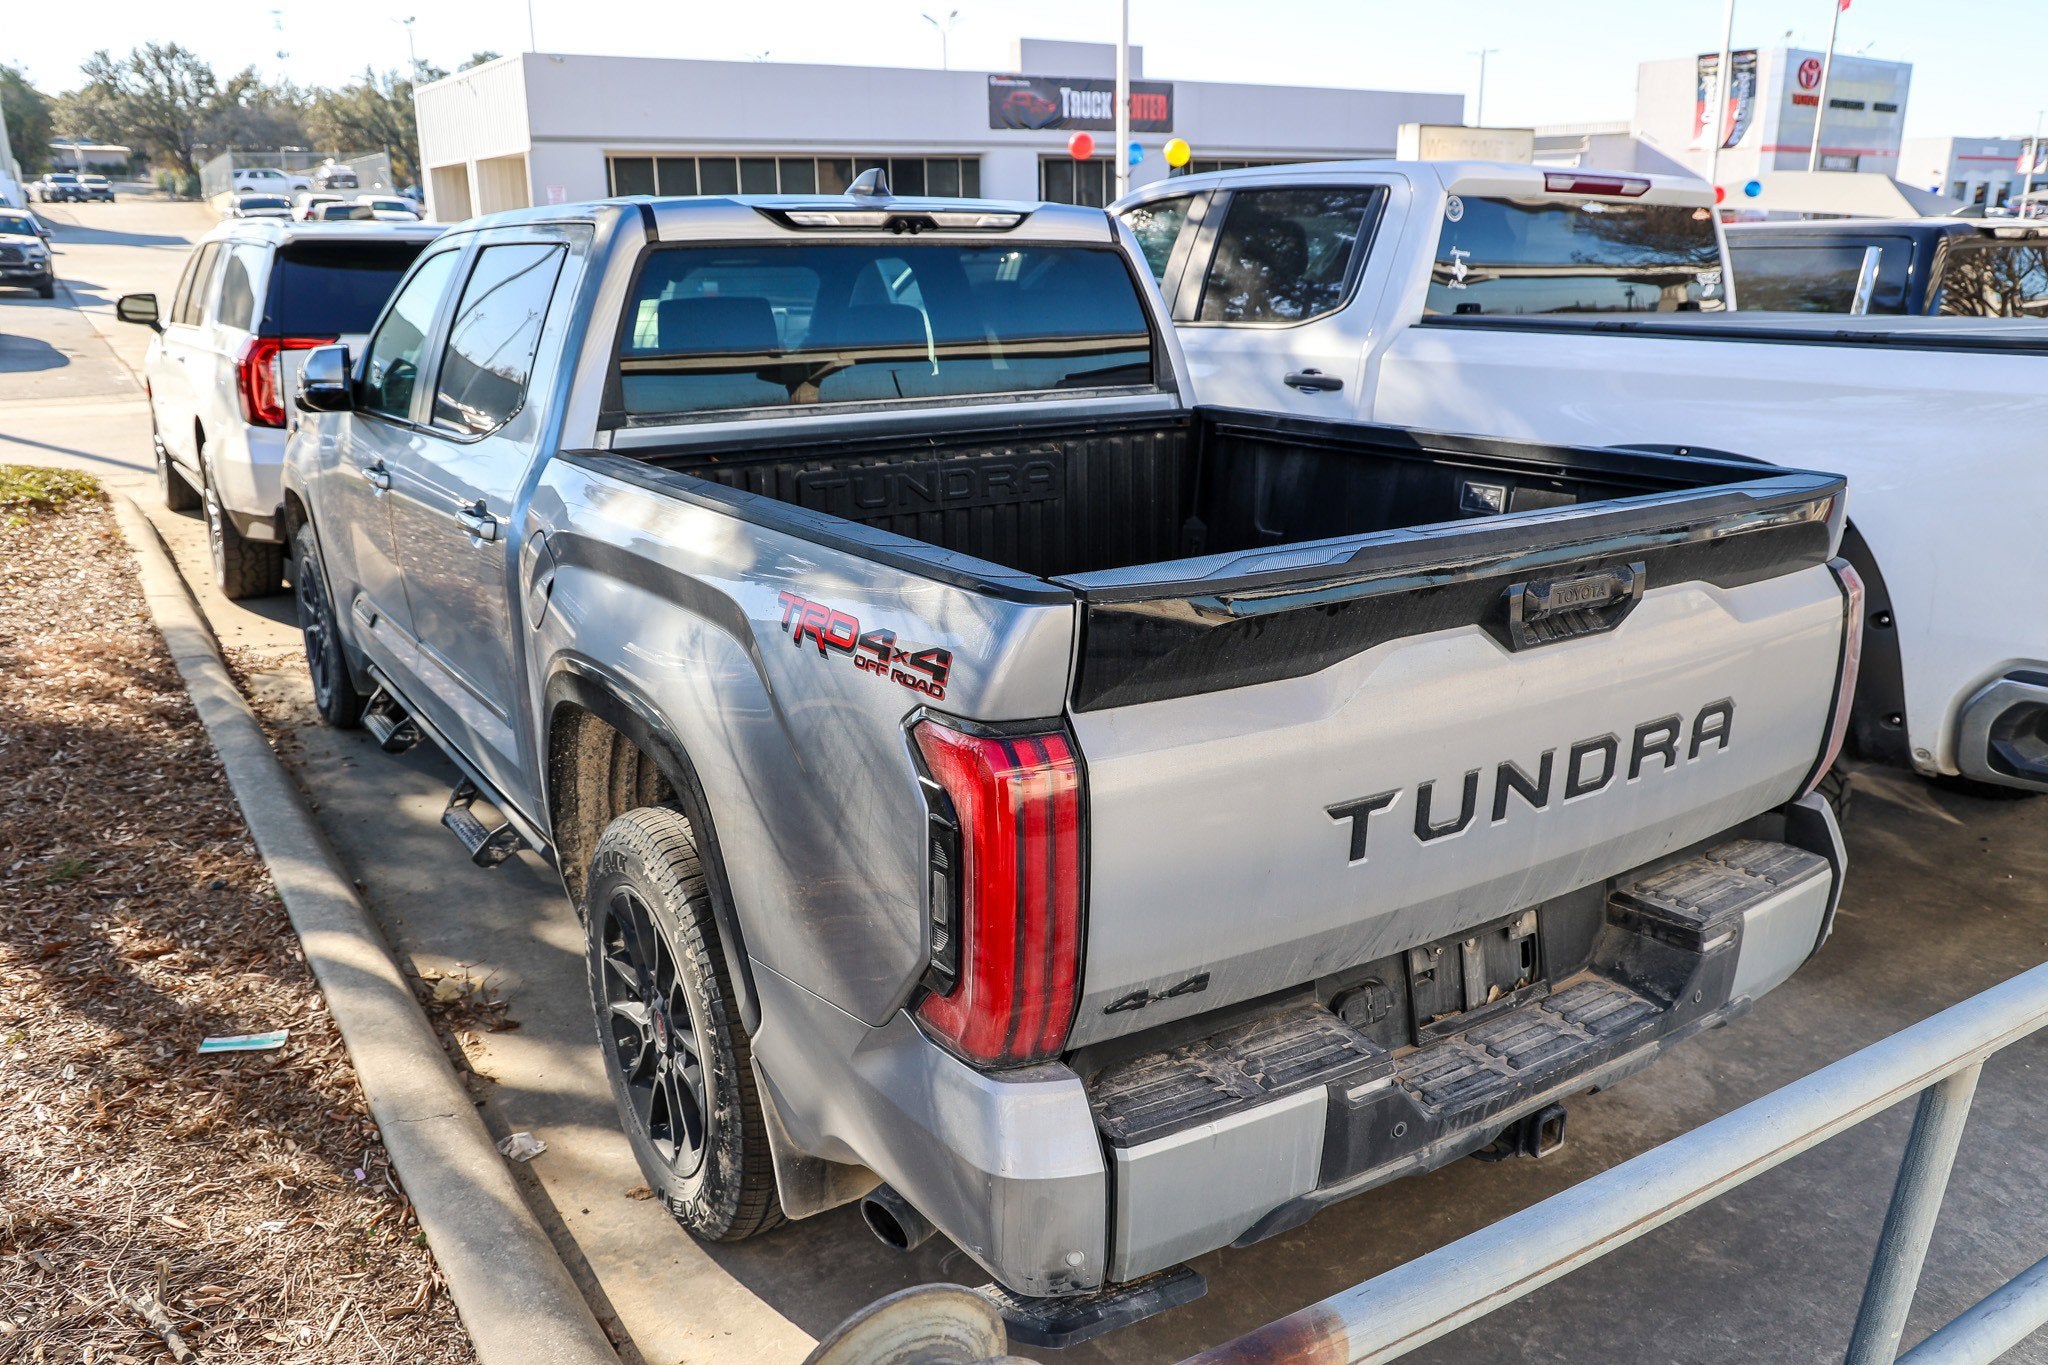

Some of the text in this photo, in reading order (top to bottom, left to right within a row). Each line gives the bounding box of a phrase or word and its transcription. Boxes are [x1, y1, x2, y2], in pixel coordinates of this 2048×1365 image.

[1060, 87, 1168, 121] TRUCK NTER
[808, 460, 1057, 512] TUNDRA
[1556, 581, 1606, 604] TOYOTA
[778, 590, 860, 660] TRD
[854, 654, 945, 701] OFF ROAD
[1324, 696, 1737, 866] TUNDRA
